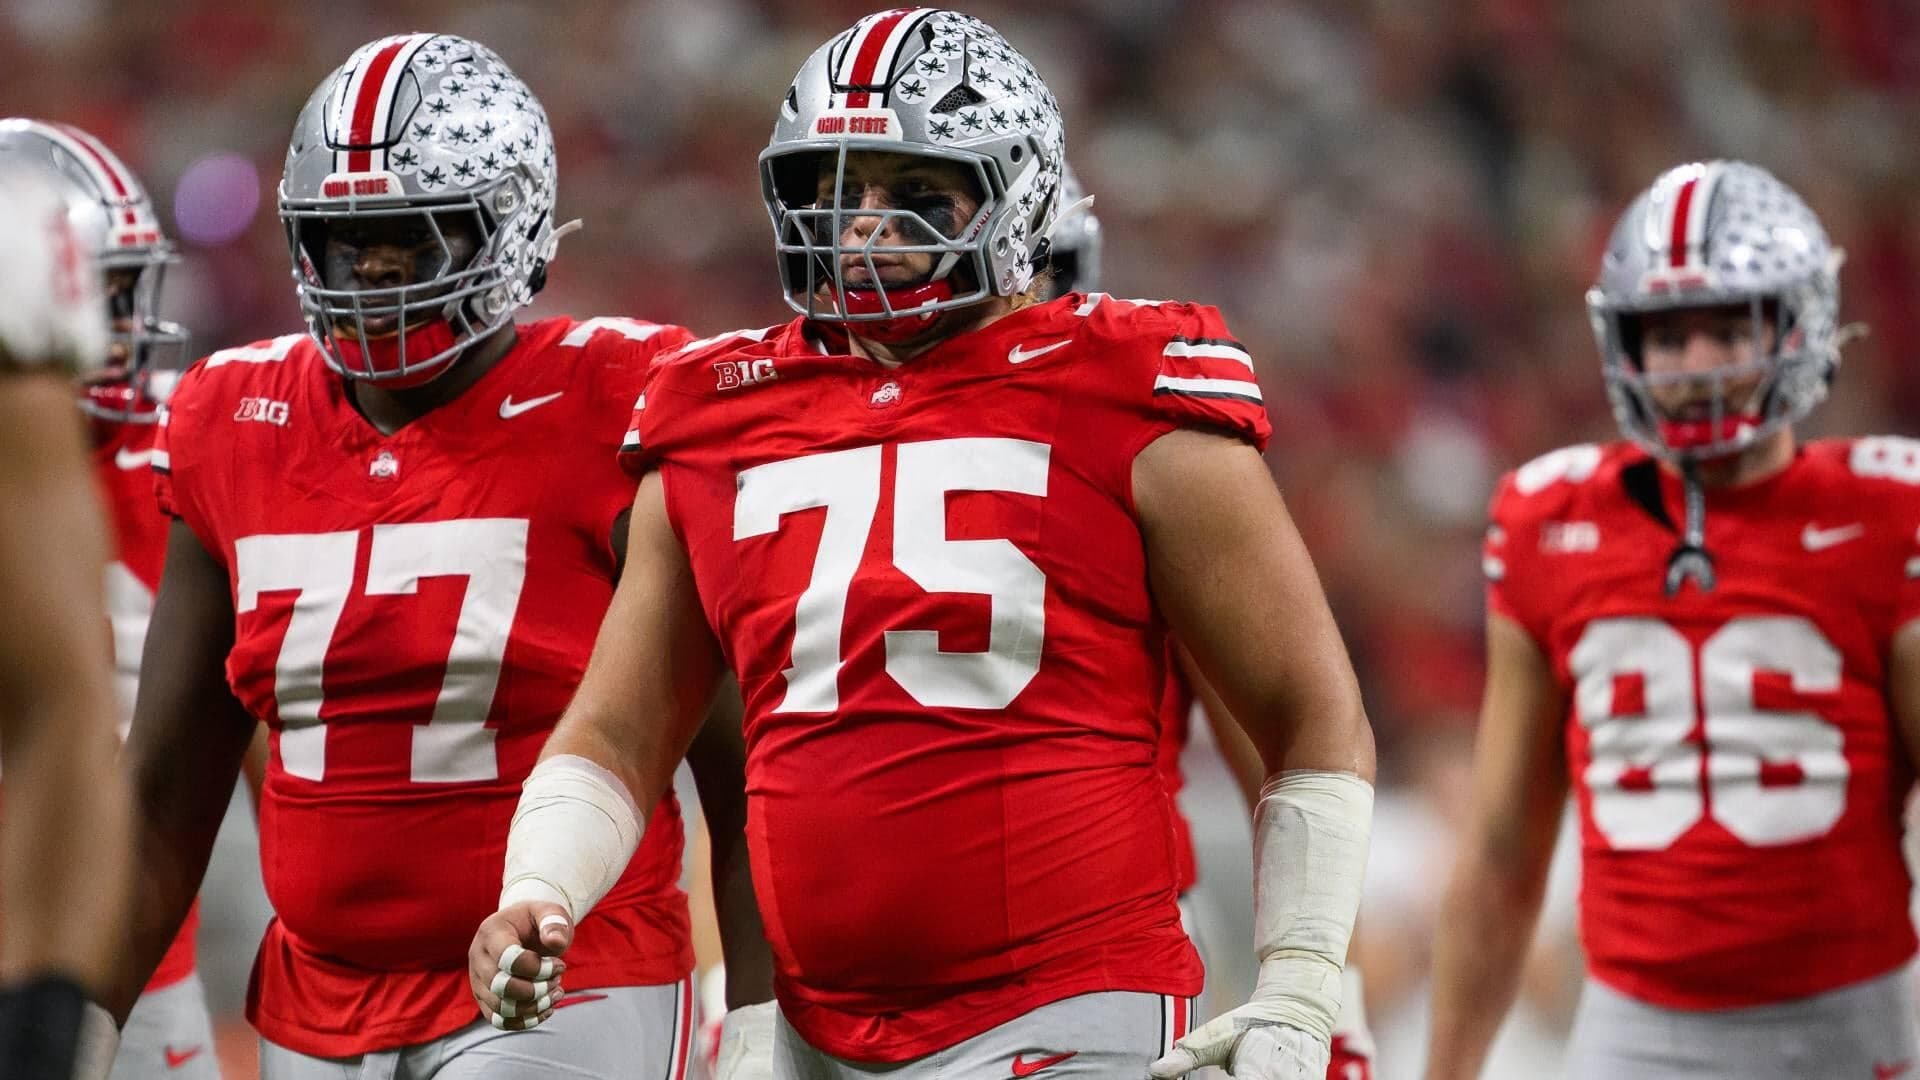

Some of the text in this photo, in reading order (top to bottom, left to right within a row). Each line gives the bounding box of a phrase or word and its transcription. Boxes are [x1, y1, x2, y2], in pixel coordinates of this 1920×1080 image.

[816, 116, 889, 134] OHIO STATE
[235, 518, 530, 783] 77
[733, 437, 1052, 714] 75
[1568, 617, 1850, 850] 86
